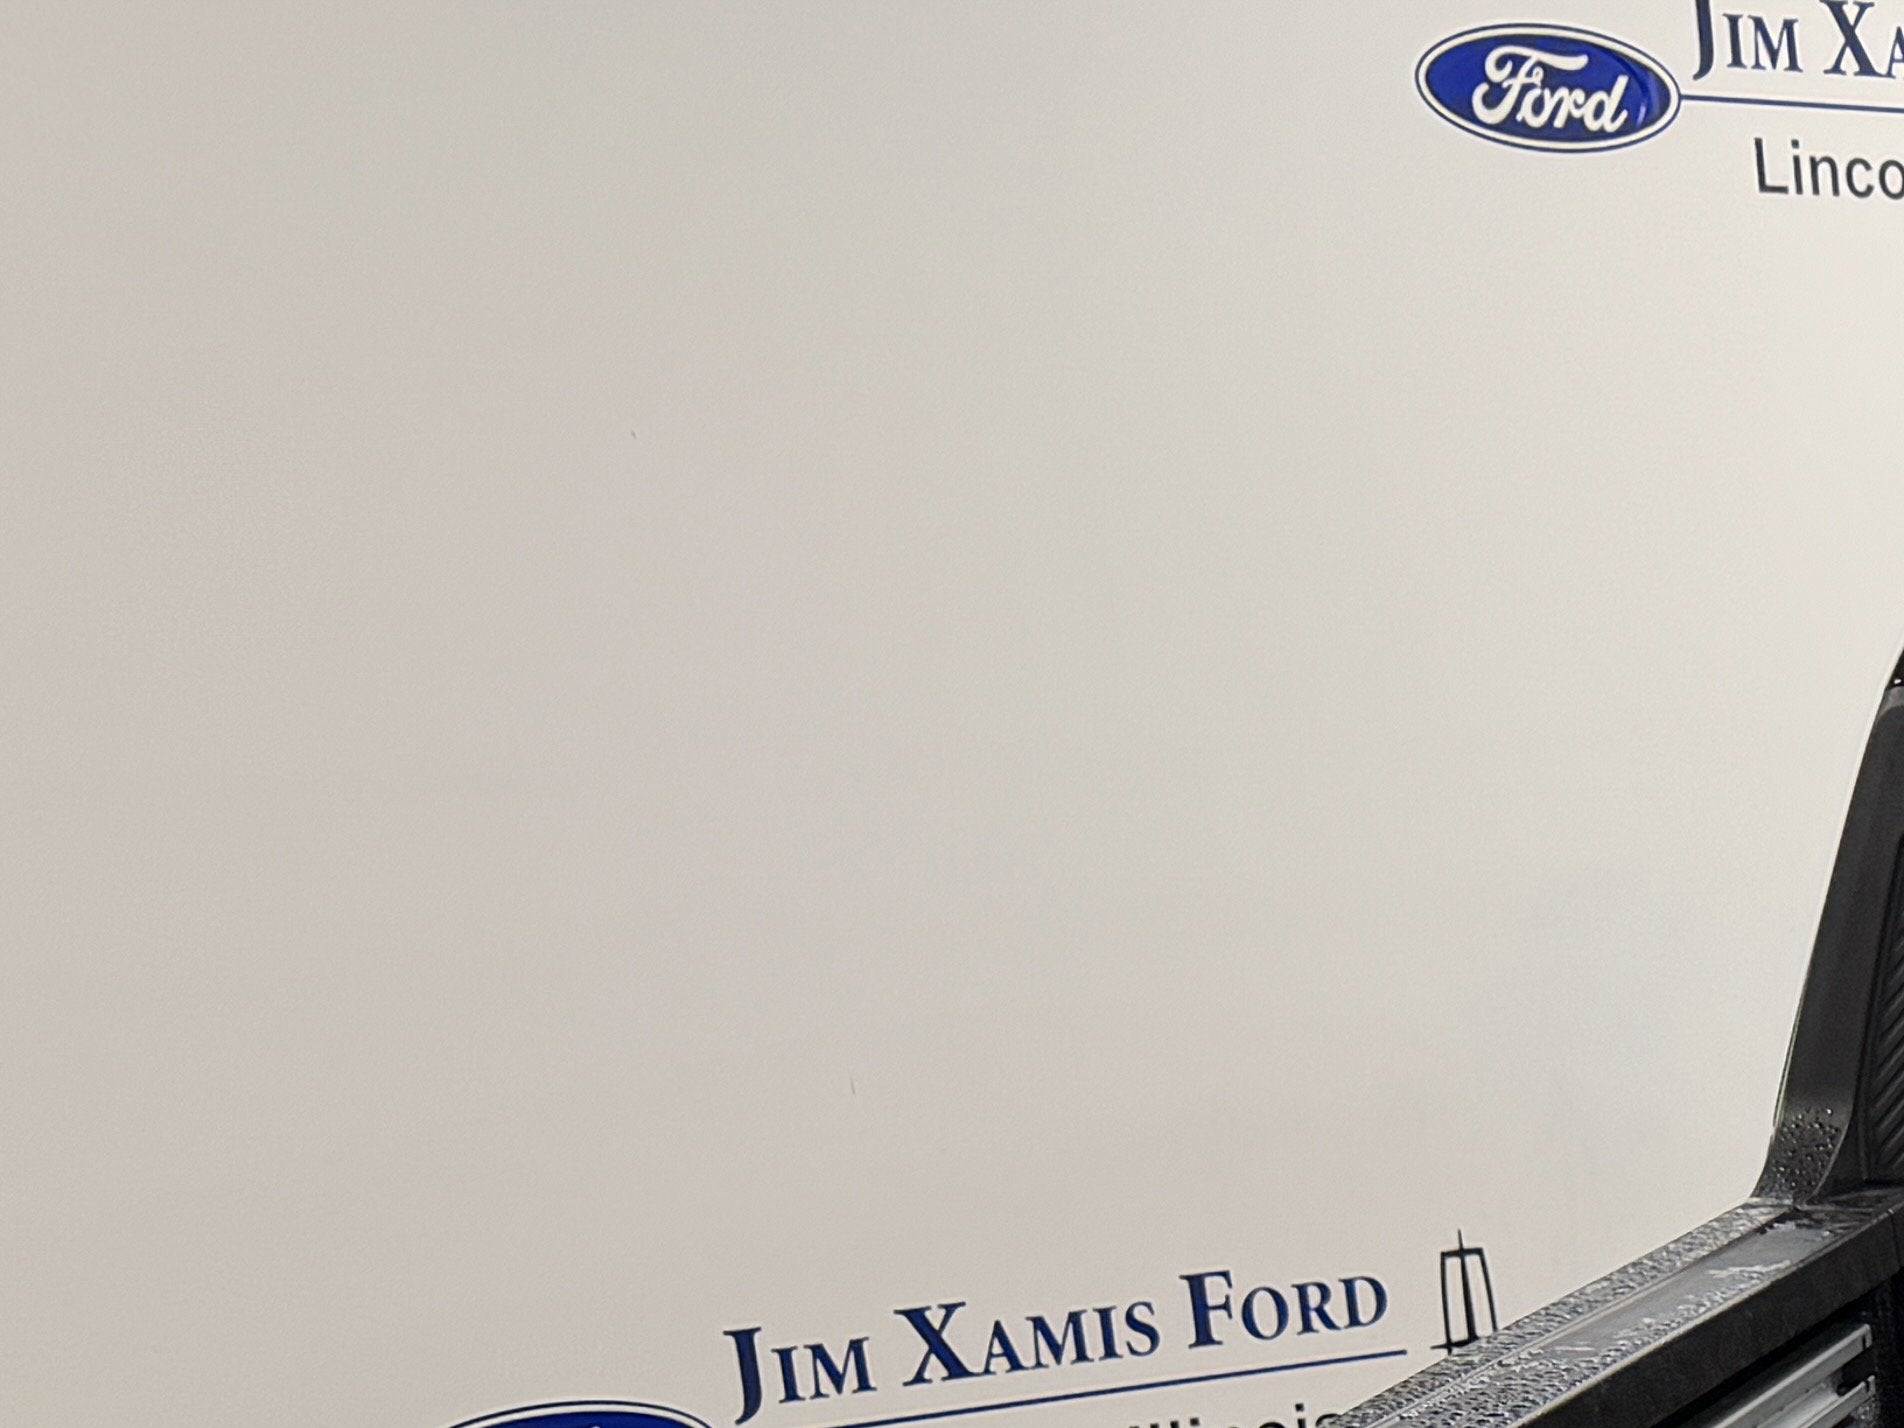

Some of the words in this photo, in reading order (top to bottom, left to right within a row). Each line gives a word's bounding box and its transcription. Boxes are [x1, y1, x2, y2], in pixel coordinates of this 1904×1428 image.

[1692, 0, 1804, 81] JIM
[1471, 45, 1630, 134] Ford
[721, 1325, 879, 1427] JIM
[892, 1300, 1161, 1388] XAMIS
[1177, 1269, 1389, 1351] FORD
